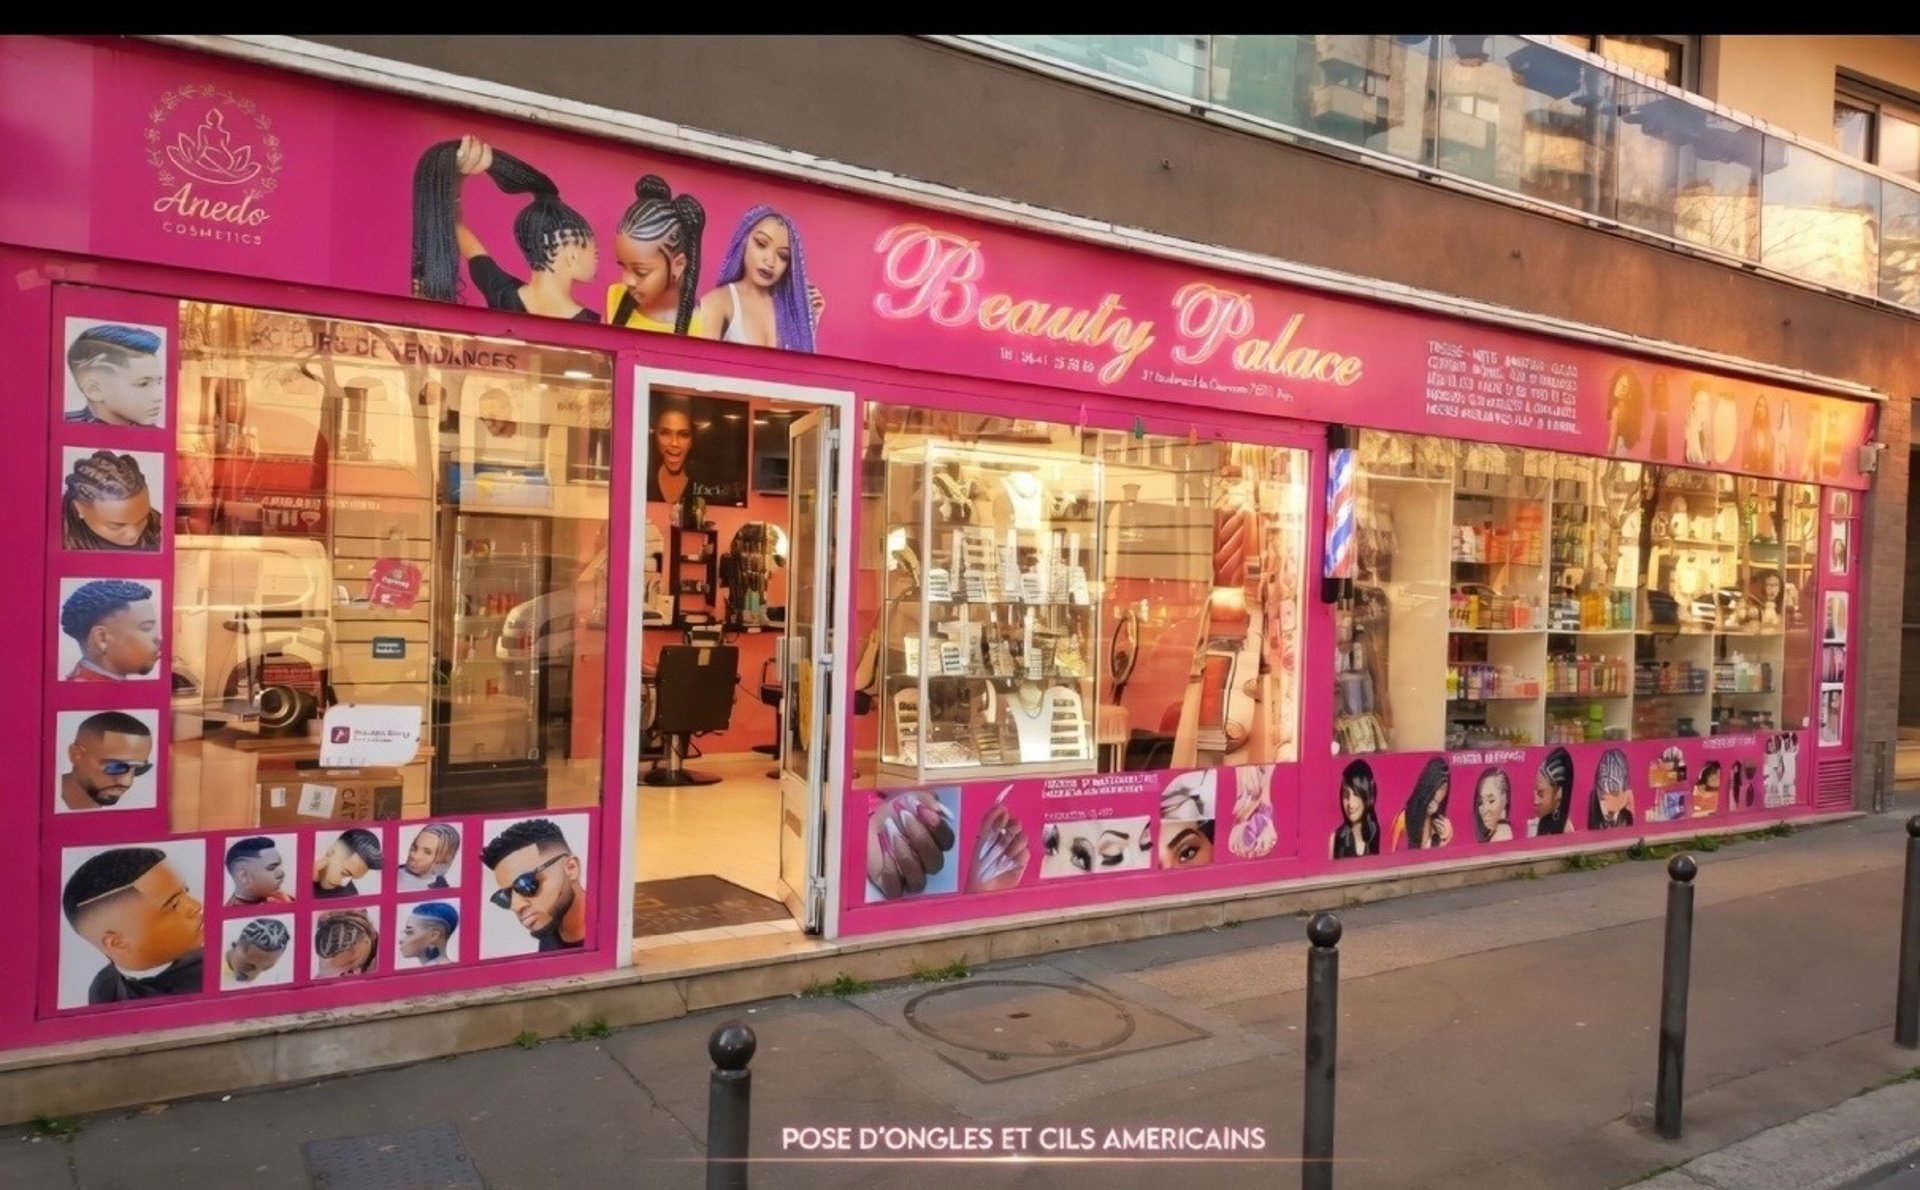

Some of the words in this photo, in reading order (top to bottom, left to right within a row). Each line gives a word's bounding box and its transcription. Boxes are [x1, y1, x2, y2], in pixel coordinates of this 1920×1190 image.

[153, 181, 270, 226] Anedo
[162, 220, 262, 246] COSMETICS
[872, 222, 1155, 385] Beauty
[1170, 281, 1364, 387] Palace
